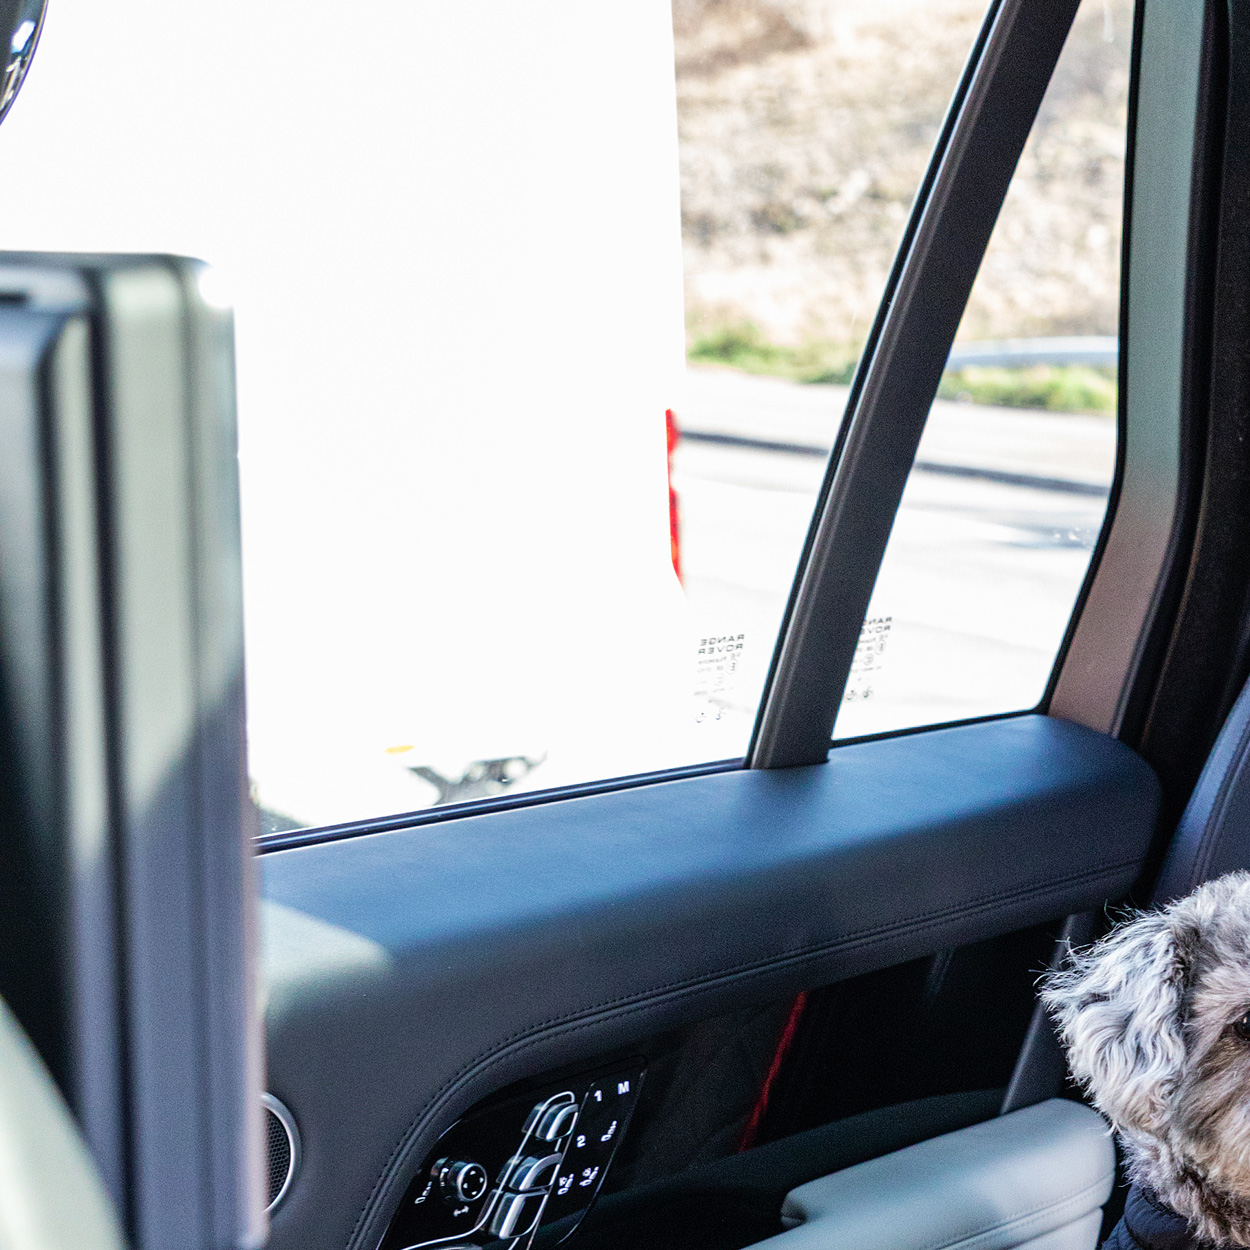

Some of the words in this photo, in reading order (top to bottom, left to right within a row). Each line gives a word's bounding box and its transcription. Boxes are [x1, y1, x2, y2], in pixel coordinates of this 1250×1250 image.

[617, 1080, 630, 1095] M
[594, 1089, 602, 1102] 1
[576, 1134, 586, 1148] 2
